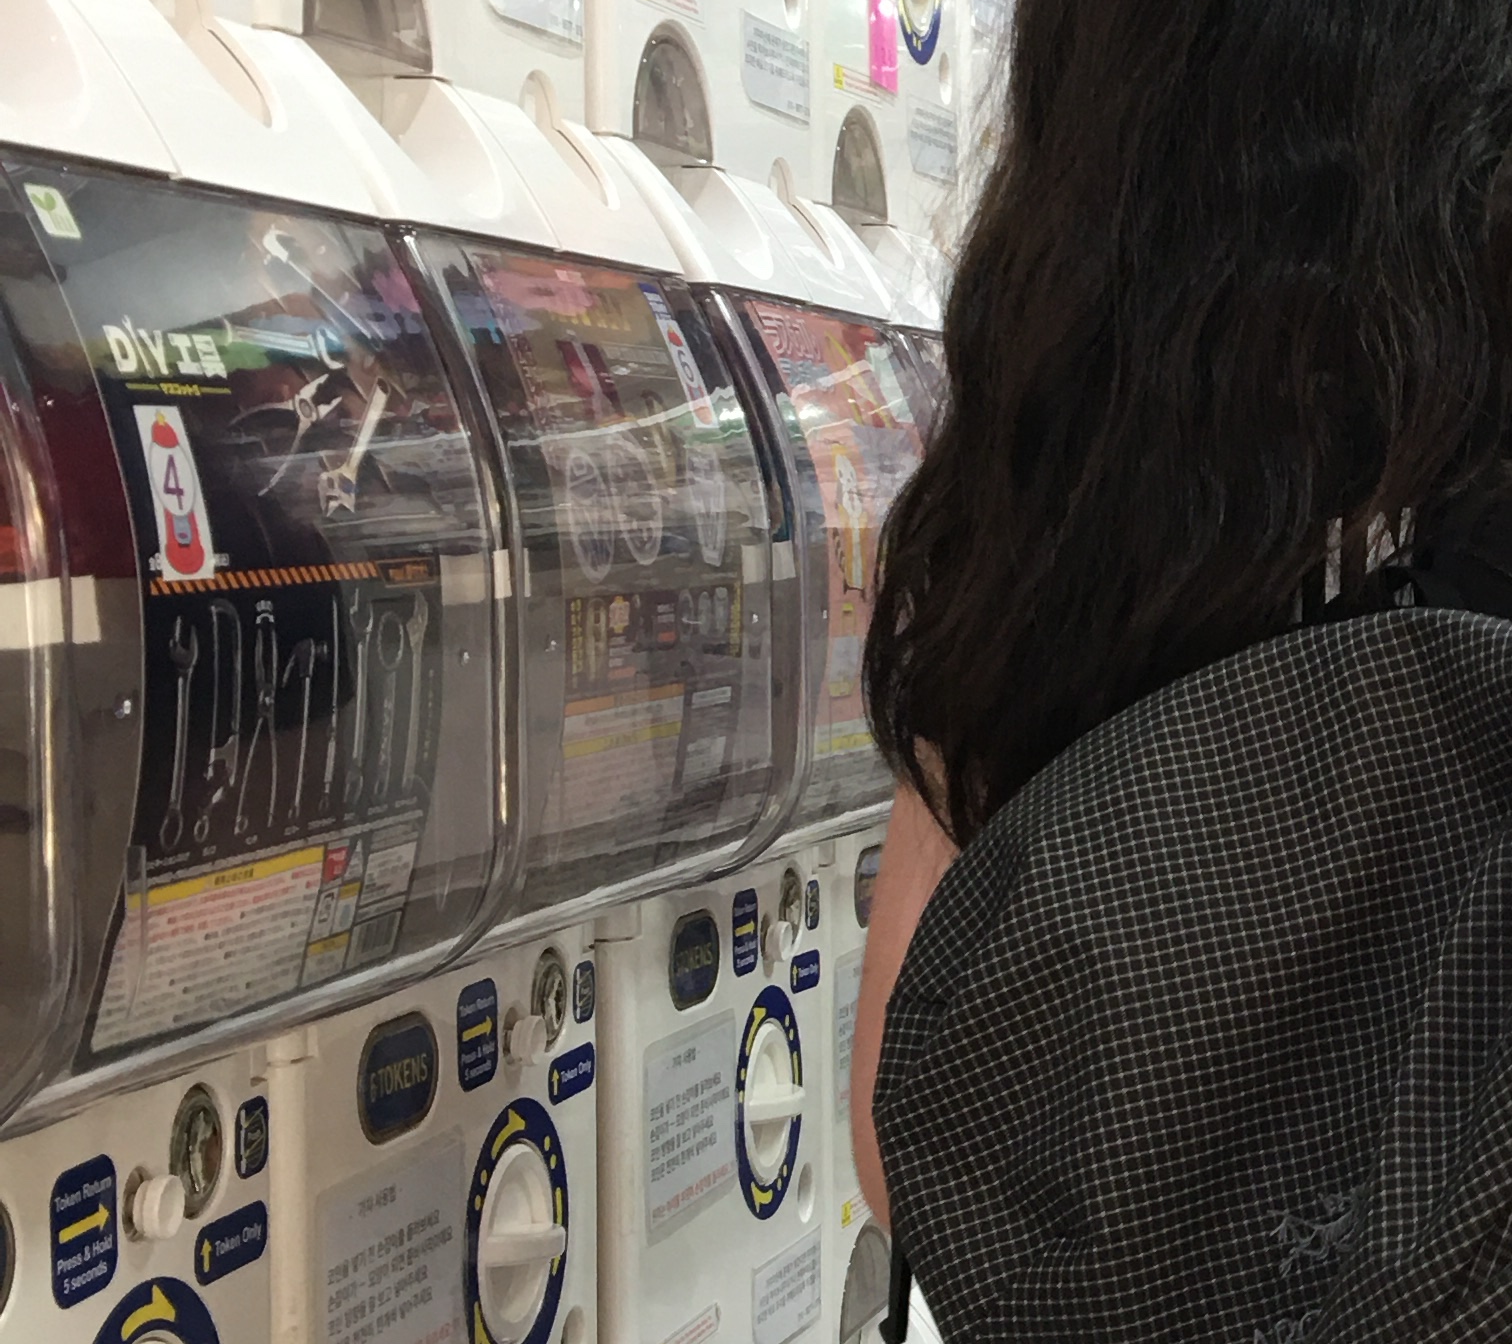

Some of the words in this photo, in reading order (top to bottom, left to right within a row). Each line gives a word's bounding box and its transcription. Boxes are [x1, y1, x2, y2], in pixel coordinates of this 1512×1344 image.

[163, 454, 185, 512] 4
[378, 1052, 428, 1098] TOKENS
[560, 1066, 578, 1082] Token
[578, 1059, 592, 1075] Only
[54, 1190, 82, 1213] Token
[82, 1176, 112, 1201] Return
[56, 1254, 82, 1276] Press
[92, 1234, 113, 1256] Hold
[214, 1235, 241, 1257] Token
[242, 1222, 263, 1243] Only
[70, 1259, 108, 1290] seconds
